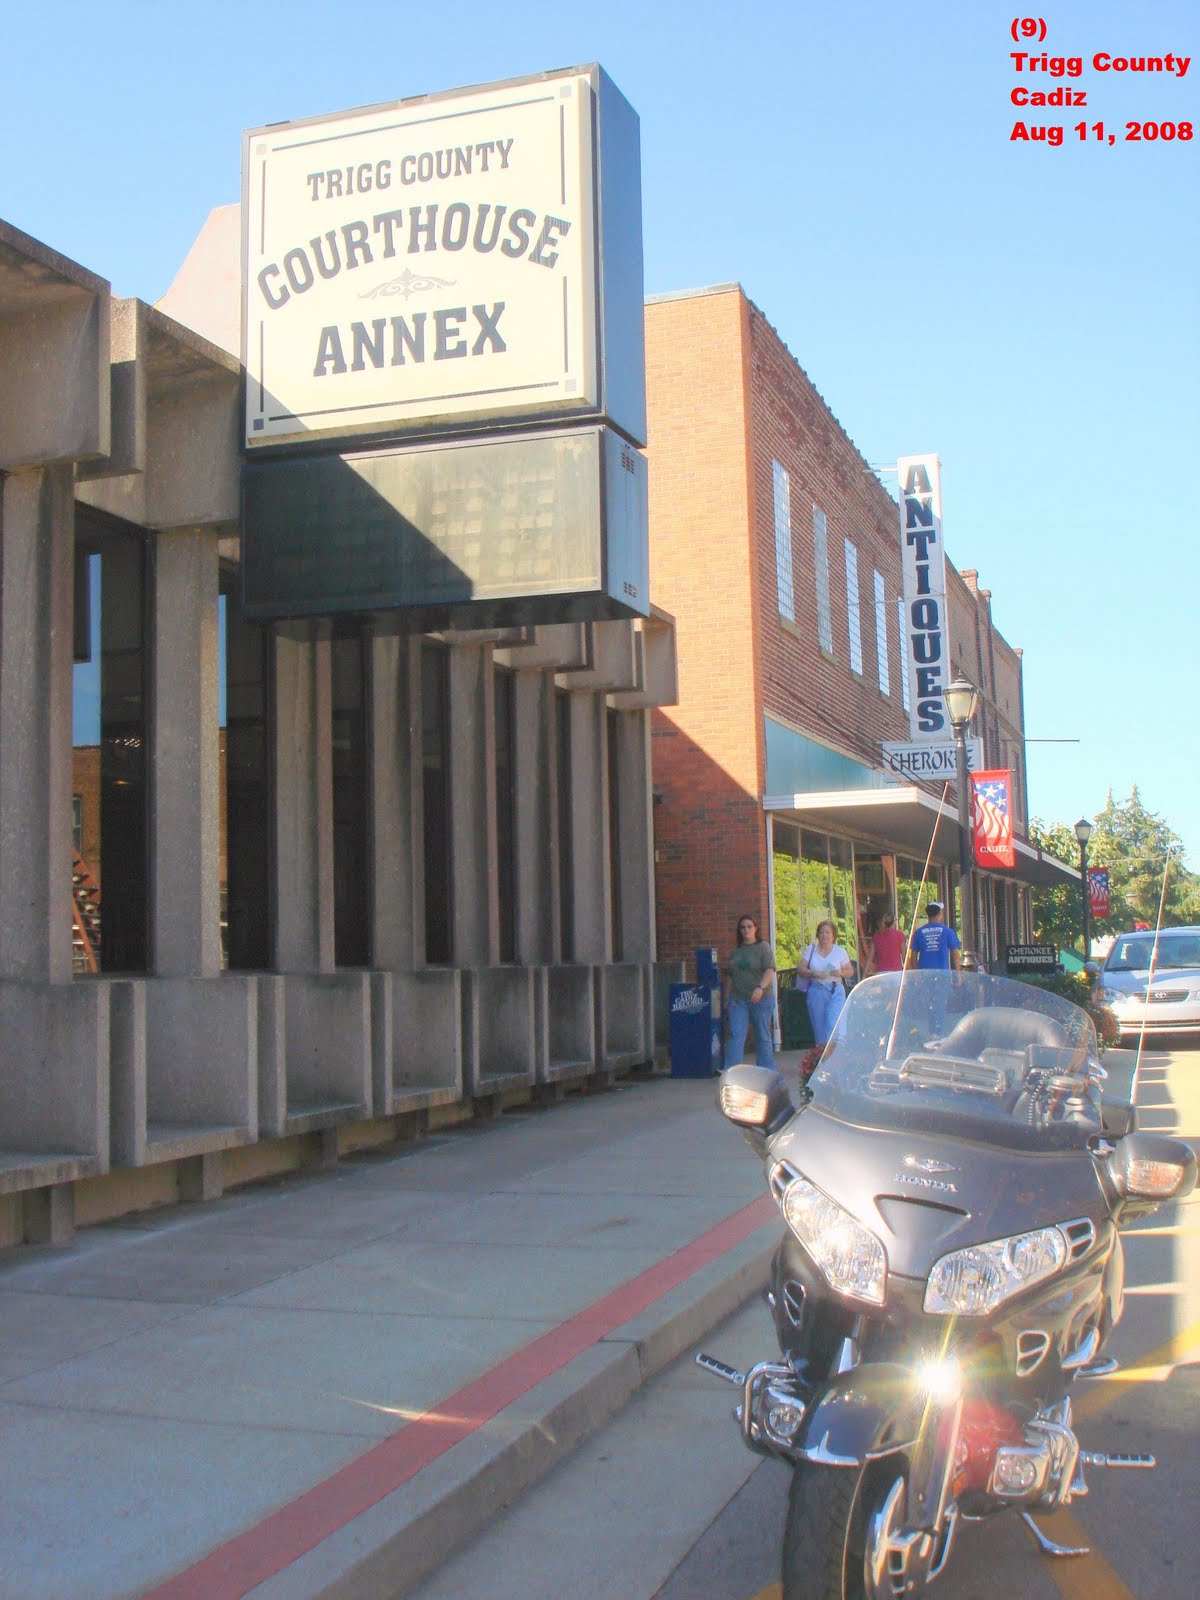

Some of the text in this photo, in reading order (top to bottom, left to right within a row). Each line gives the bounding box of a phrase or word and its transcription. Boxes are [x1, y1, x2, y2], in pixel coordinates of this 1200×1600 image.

[307, 138, 514, 202] TRIGG COUNTY
[257, 202, 571, 310] COURTHOUSE
[313, 301, 507, 377] ANNEX
[904, 463, 944, 733] ANTIQUES
[889, 747, 974, 772] CHEROKE
[980, 845, 1007, 853] CADIZ
[1008, 956, 1053, 964] ANTIQUES
[1009, 947, 1052, 955] CHEROKEE
[893, 1174, 958, 1192] HONDA
